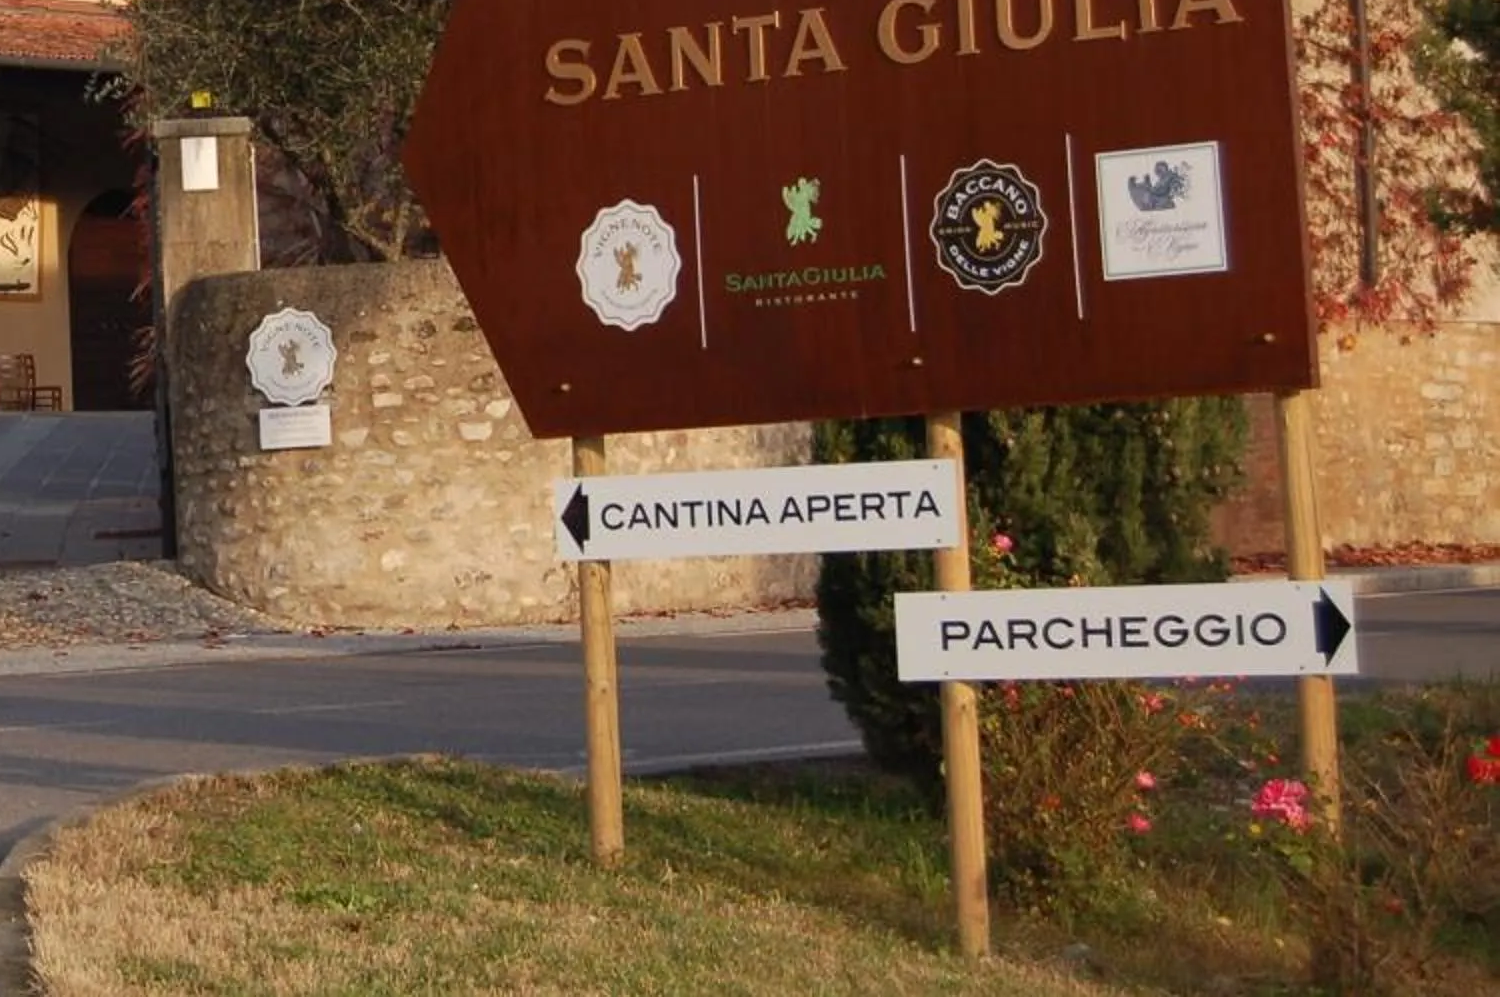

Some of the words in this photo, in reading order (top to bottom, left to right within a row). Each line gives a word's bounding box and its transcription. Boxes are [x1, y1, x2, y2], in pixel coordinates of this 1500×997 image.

[544, 8, 847, 105] SANTA
[946, 176, 1027, 220] BACCANO
[949, 244, 990, 277] DELLE
[992, 238, 1030, 276] VIGNE
[755, 290, 860, 308] RISTORANTE
[601, 498, 770, 531] CANTINA
[779, 490, 942, 524] APERTA
[939, 612, 1288, 651] PARCHEGGIO
